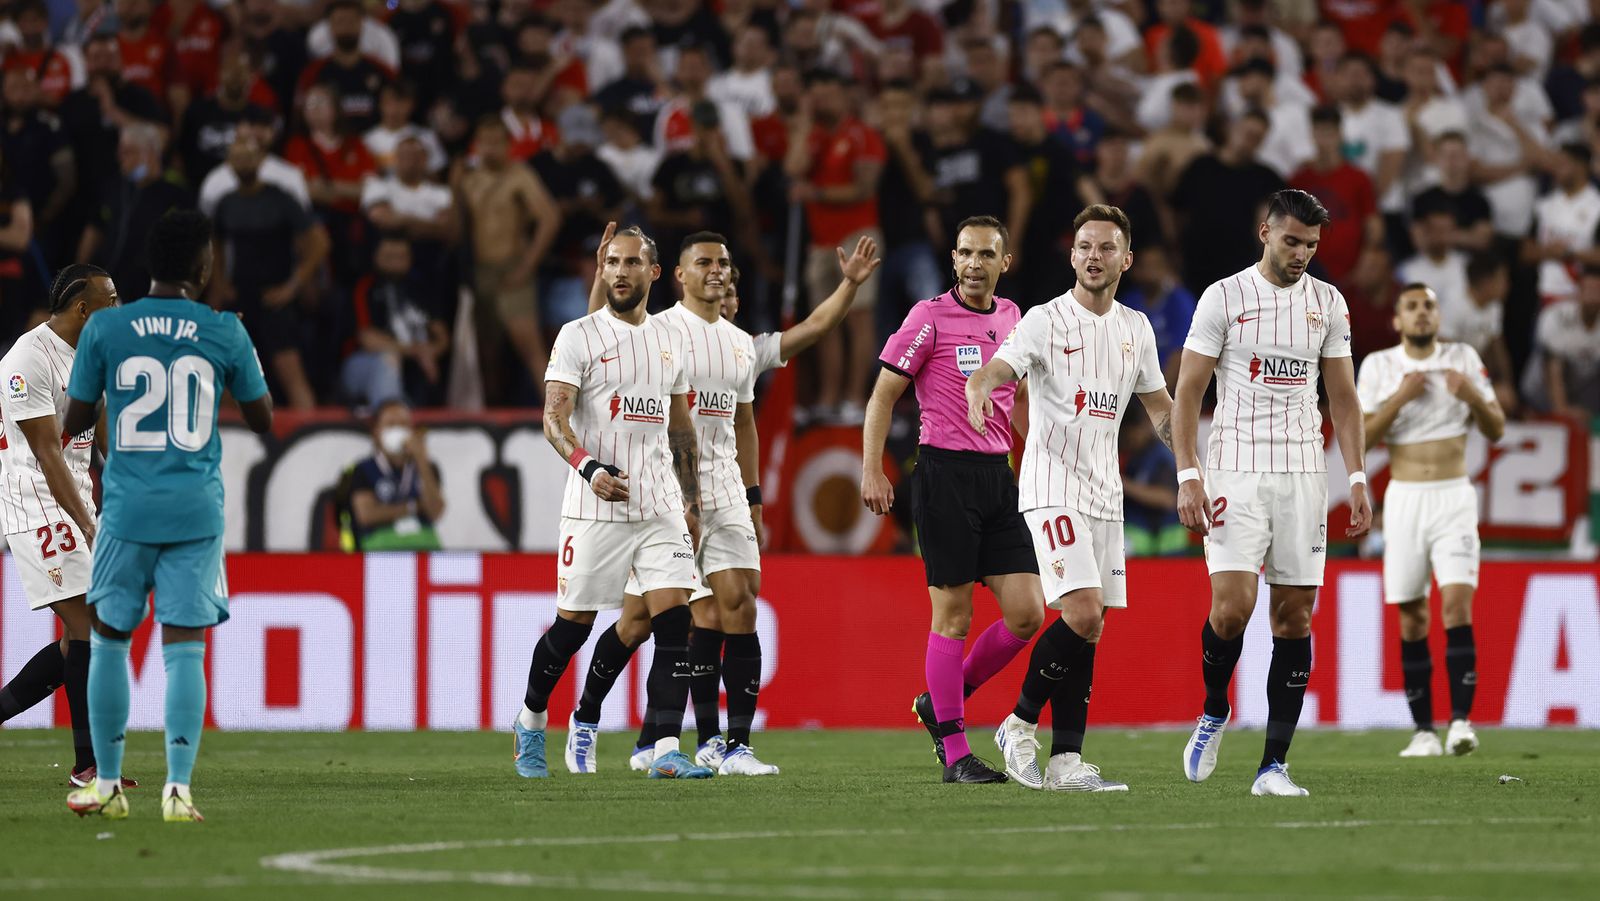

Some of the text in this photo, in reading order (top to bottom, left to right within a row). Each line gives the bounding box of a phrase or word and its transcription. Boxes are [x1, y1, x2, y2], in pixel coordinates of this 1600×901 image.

[131, 316, 199, 342] VINI JR.
[904, 323, 932, 358] WÜRTH
[958, 347, 979, 356] FIFA
[1264, 358, 1308, 378] NAGA
[115, 354, 215, 452] 20
[623, 396, 665, 416] NAGA
[699, 391, 733, 410] NAGA
[1088, 390, 1118, 412] NAGA
[37, 522, 77, 560] 23
[1042, 514, 1076, 551] 10
[562, 535, 574, 567] 6
[1291, 671, 1310, 679] SFC
